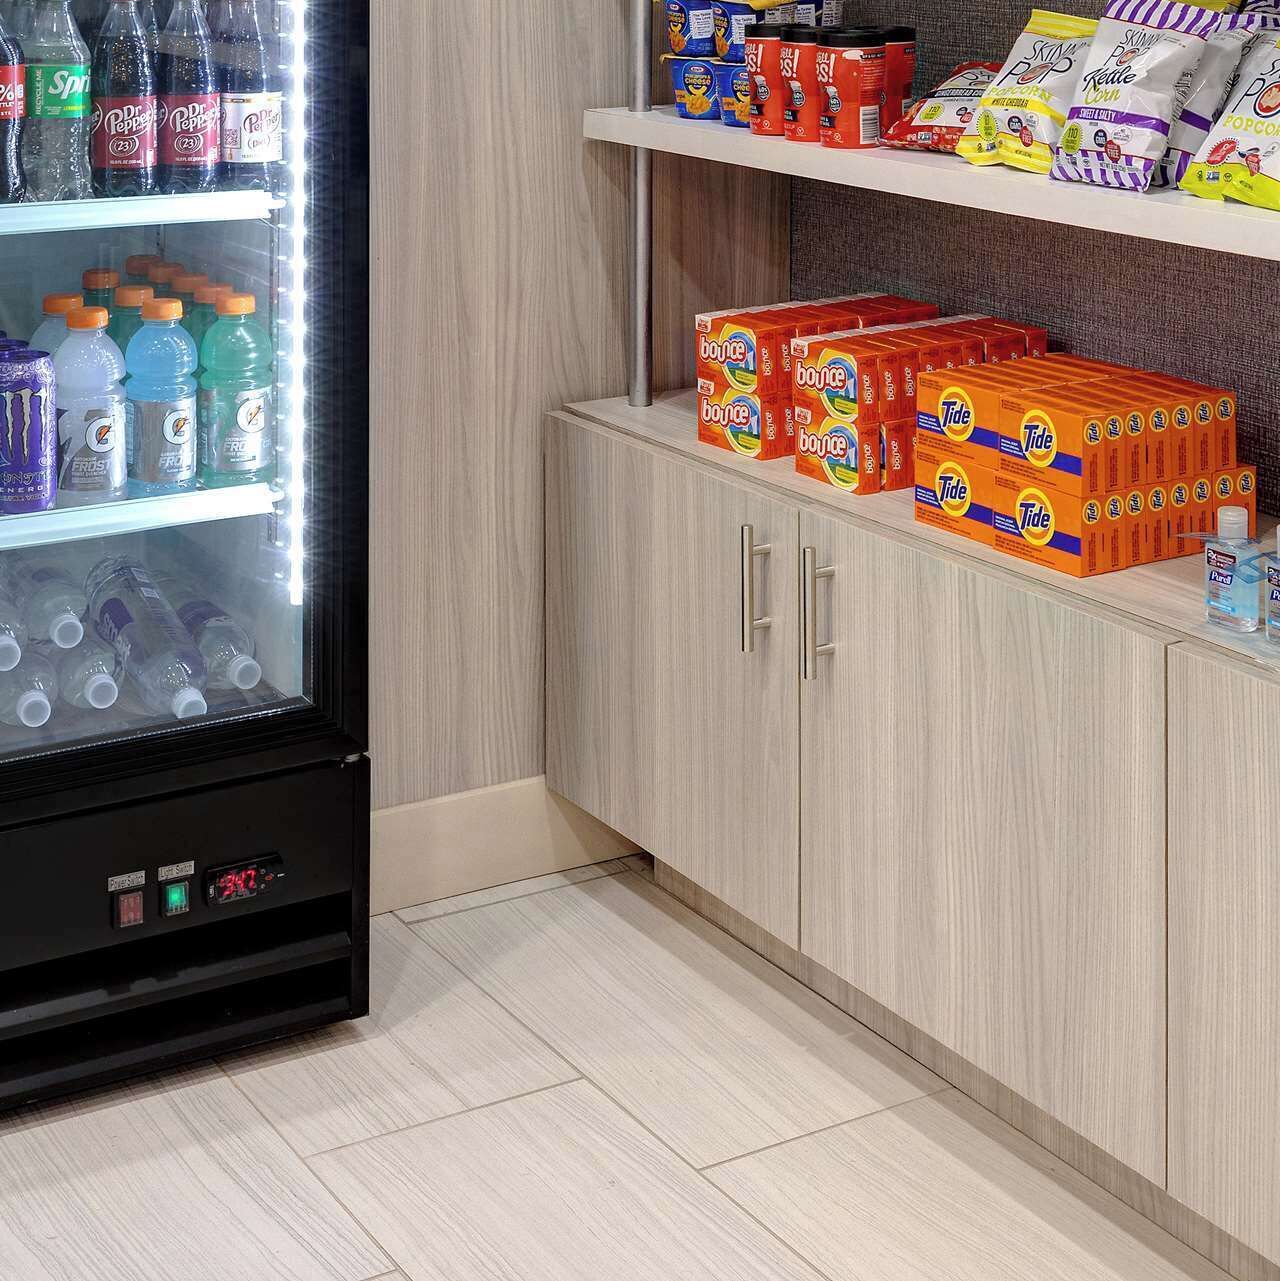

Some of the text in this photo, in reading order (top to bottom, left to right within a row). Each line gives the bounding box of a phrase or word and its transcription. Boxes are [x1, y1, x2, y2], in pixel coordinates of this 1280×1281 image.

[997, 57, 1073, 86] POP
[1083, 67, 1137, 92] Kettle
[48, 71, 90, 99] Spri
[989, 87, 1053, 102] POPCORN
[1084, 87, 1120, 104] Corn
[106, 108, 152, 135] Pepper
[124, 105, 143, 120] Dr
[170, 107, 217, 133] Pepper
[188, 103, 206, 118] Dr
[118, 139, 133, 150] 23
[182, 136, 195, 148] 23
[700, 336, 747, 363] bounce
[796, 362, 846, 392] bounce
[702, 399, 750, 427] bounce
[941, 400, 971, 428] Tide
[799, 427, 848, 458] bounce
[1022, 425, 1053, 454] Tide
[938, 476, 968, 502] Tide
[1018, 502, 1051, 531] Tide
[1211, 572, 1232, 583] Purell
